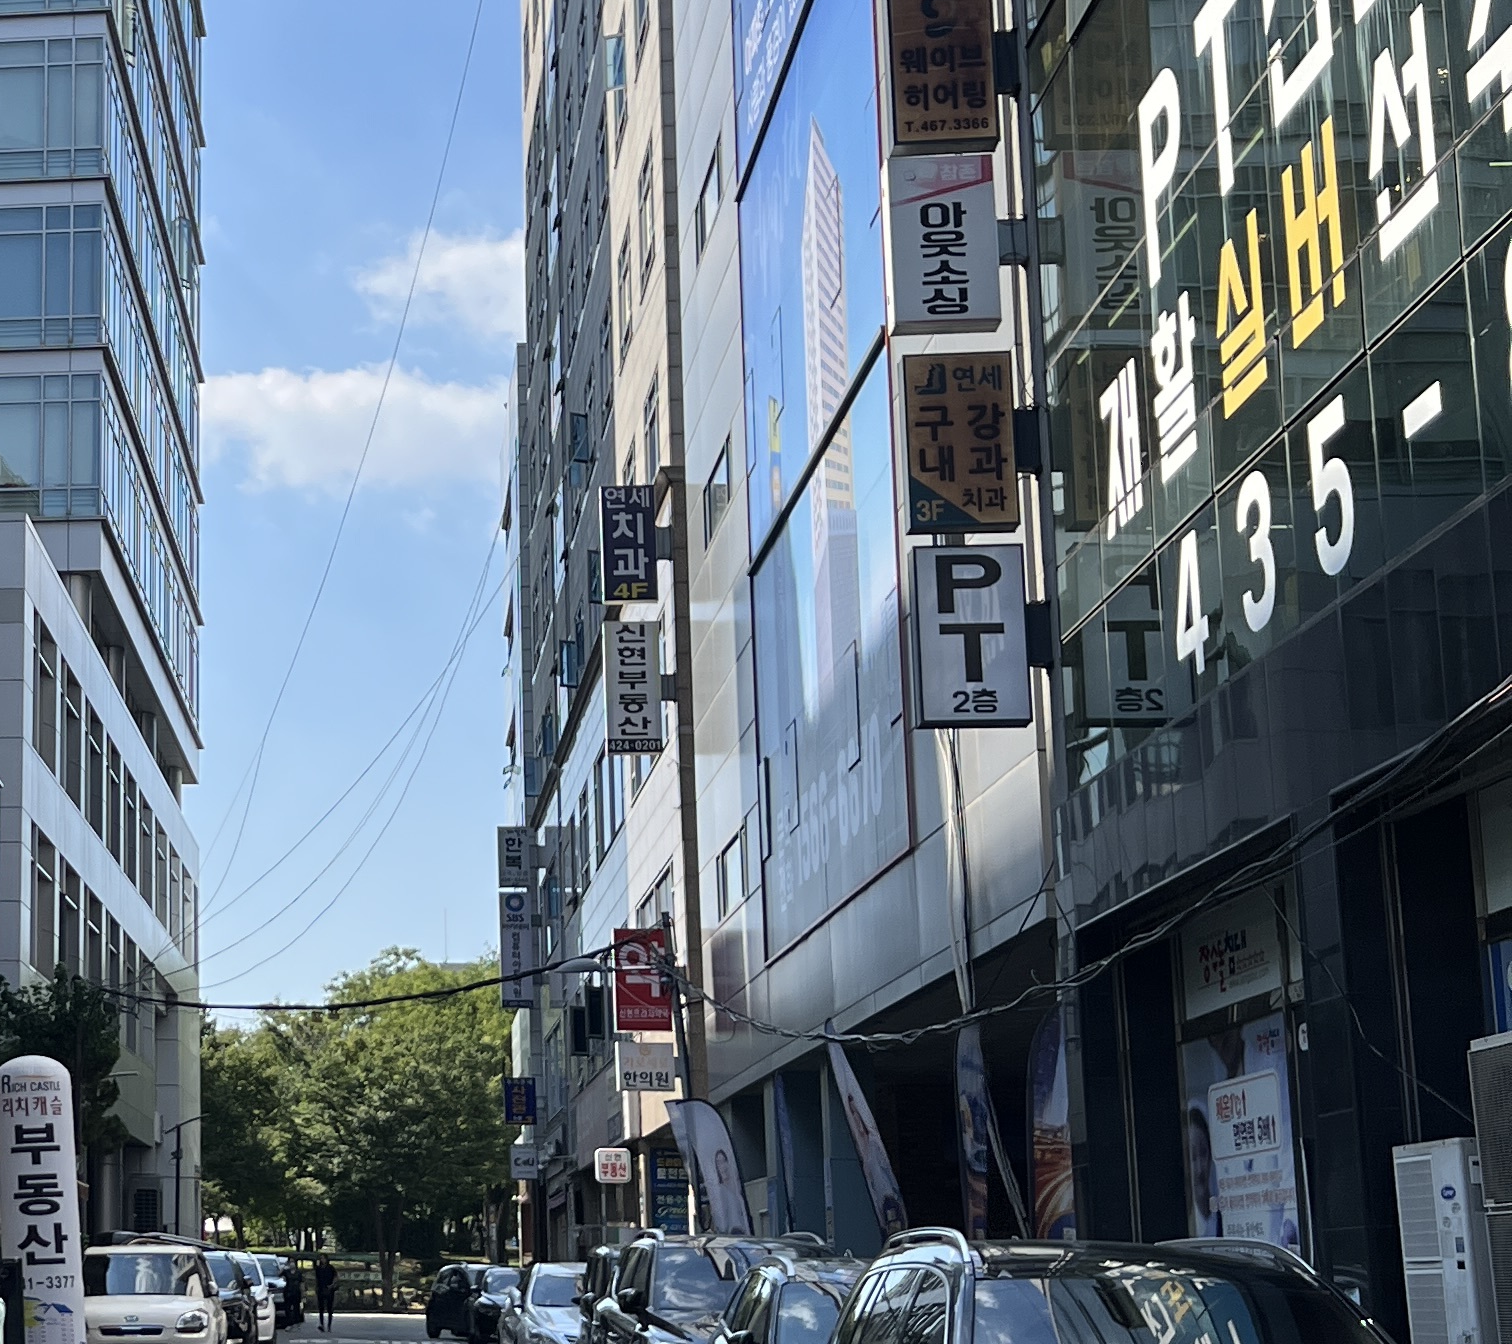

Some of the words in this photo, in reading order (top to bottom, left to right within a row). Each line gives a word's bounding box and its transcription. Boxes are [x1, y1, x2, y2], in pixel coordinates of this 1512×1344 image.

[904, 81, 987, 110] 히어링
[905, 115, 989, 134] T.467.3366
[919, 201, 970, 315] 아웃소싱
[1100, 291, 1197, 539] 재활
[1216, 115, 1345, 419] 실버
[952, 365, 1003, 392] 연세
[604, 488, 650, 509] 연세
[915, 499, 945, 522] 3F
[961, 485, 1008, 514] 치과
[612, 511, 649, 580] 치과
[613, 582, 649, 598] 4F
[936, 555, 1004, 682] PT
[616, 624, 651, 736] 신현부동산
[953, 688, 999, 714] 2층
[609, 740, 661, 752] 424-0201
[506, 914, 524, 923] SBS
[618, 940, 666, 998] 약
[30, 1081, 61, 1092] CASTLE
[623, 1071, 670, 1087] 한의원
[2, 1096, 62, 1117] 리치캐슬
[601, 1163, 627, 1178] 부동산
[10, 1123, 68, 1266] 부동산
[22, 1275, 75, 1291] 1-3377
